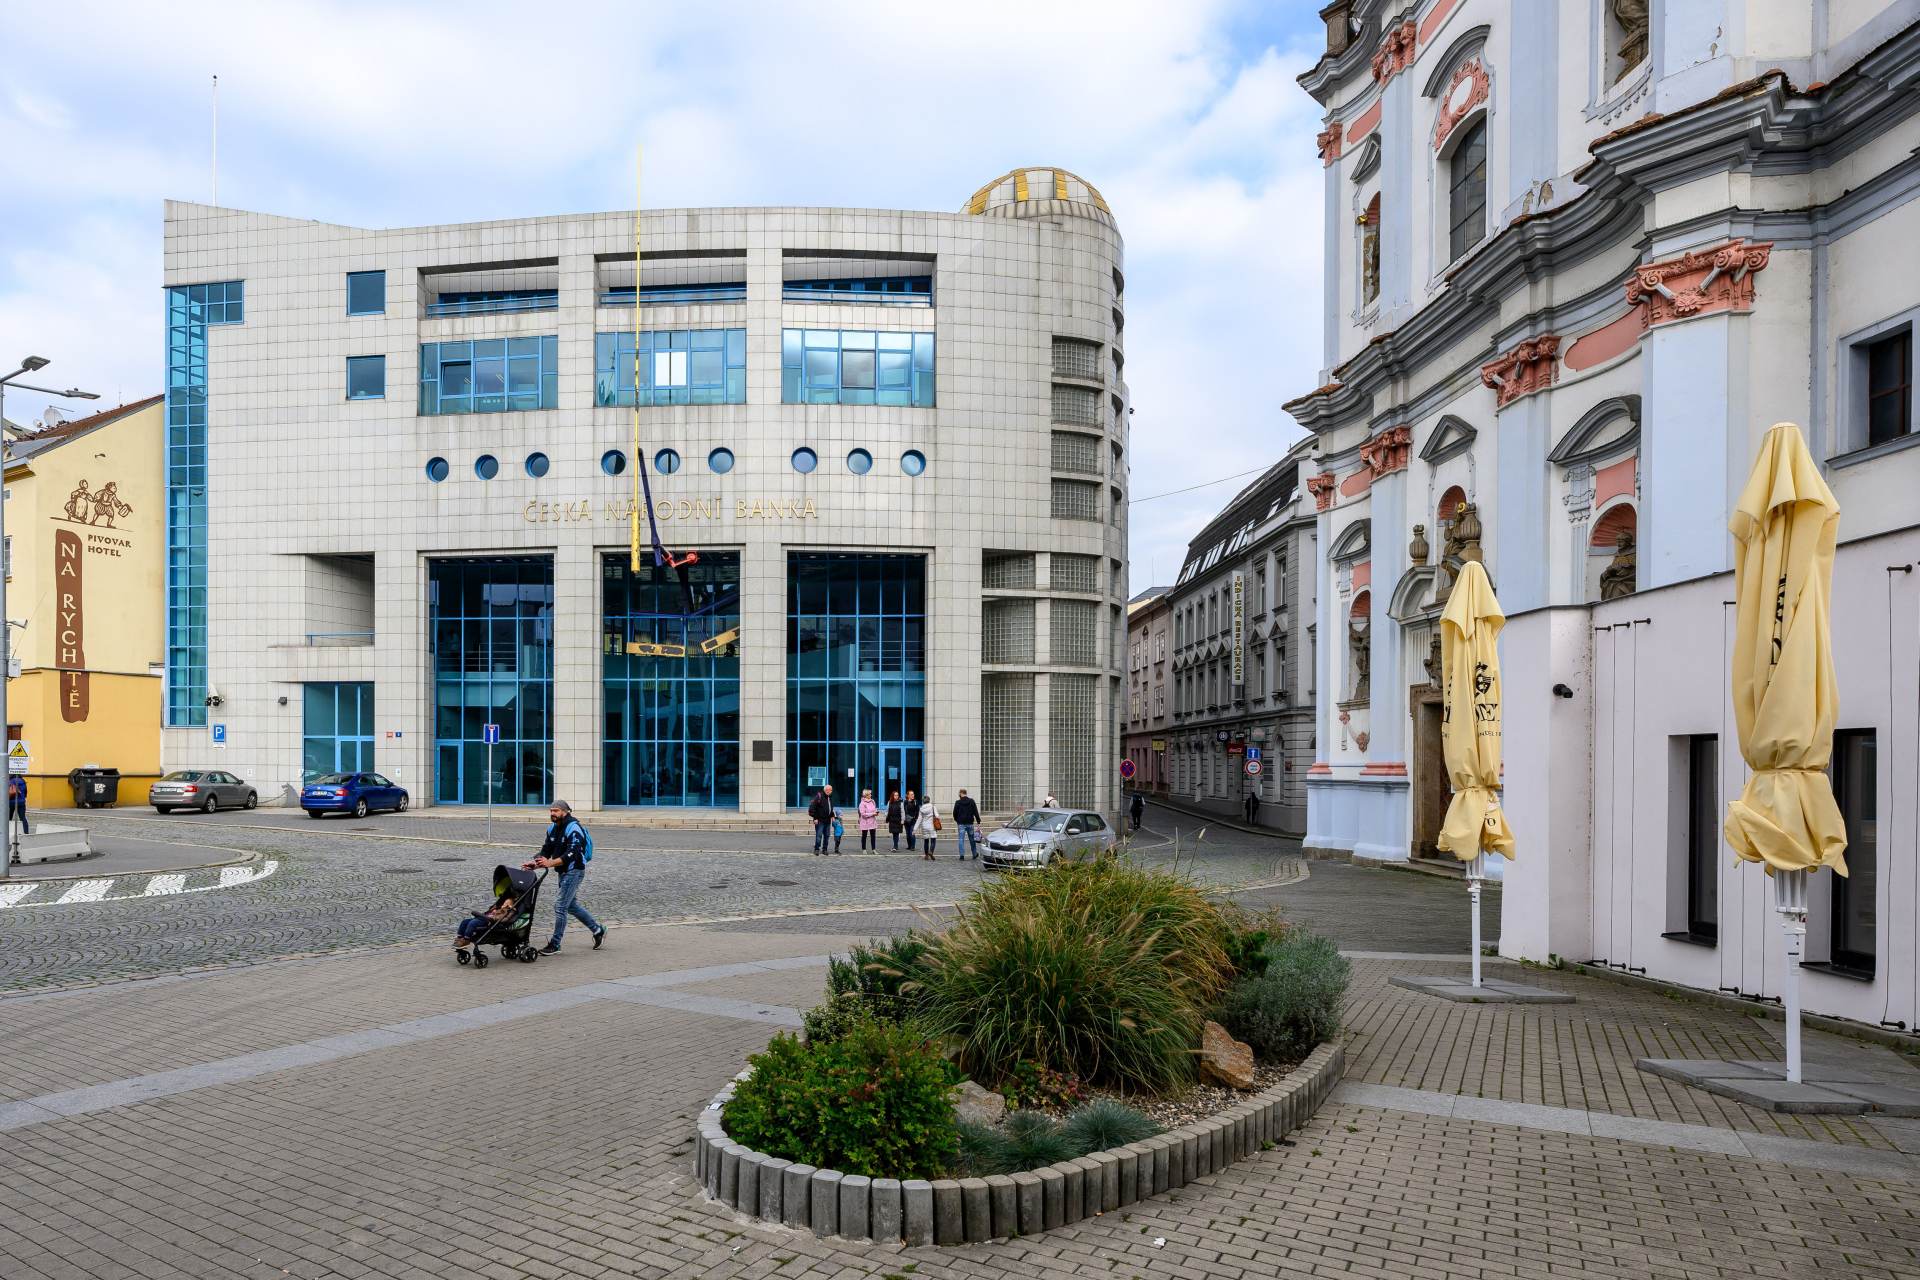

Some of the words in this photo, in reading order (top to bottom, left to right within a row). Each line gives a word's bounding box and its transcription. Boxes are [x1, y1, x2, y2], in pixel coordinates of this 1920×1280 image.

[523, 497, 593, 523] ČESKÁ
[736, 498, 817, 520] BANKA
[87, 533, 132, 548] PIVOVAR
[60, 542, 76, 577] NA
[87, 545, 122, 558] HOTEL
[61, 593, 82, 708] RYCHTĚ
[215, 726, 223, 739] P
